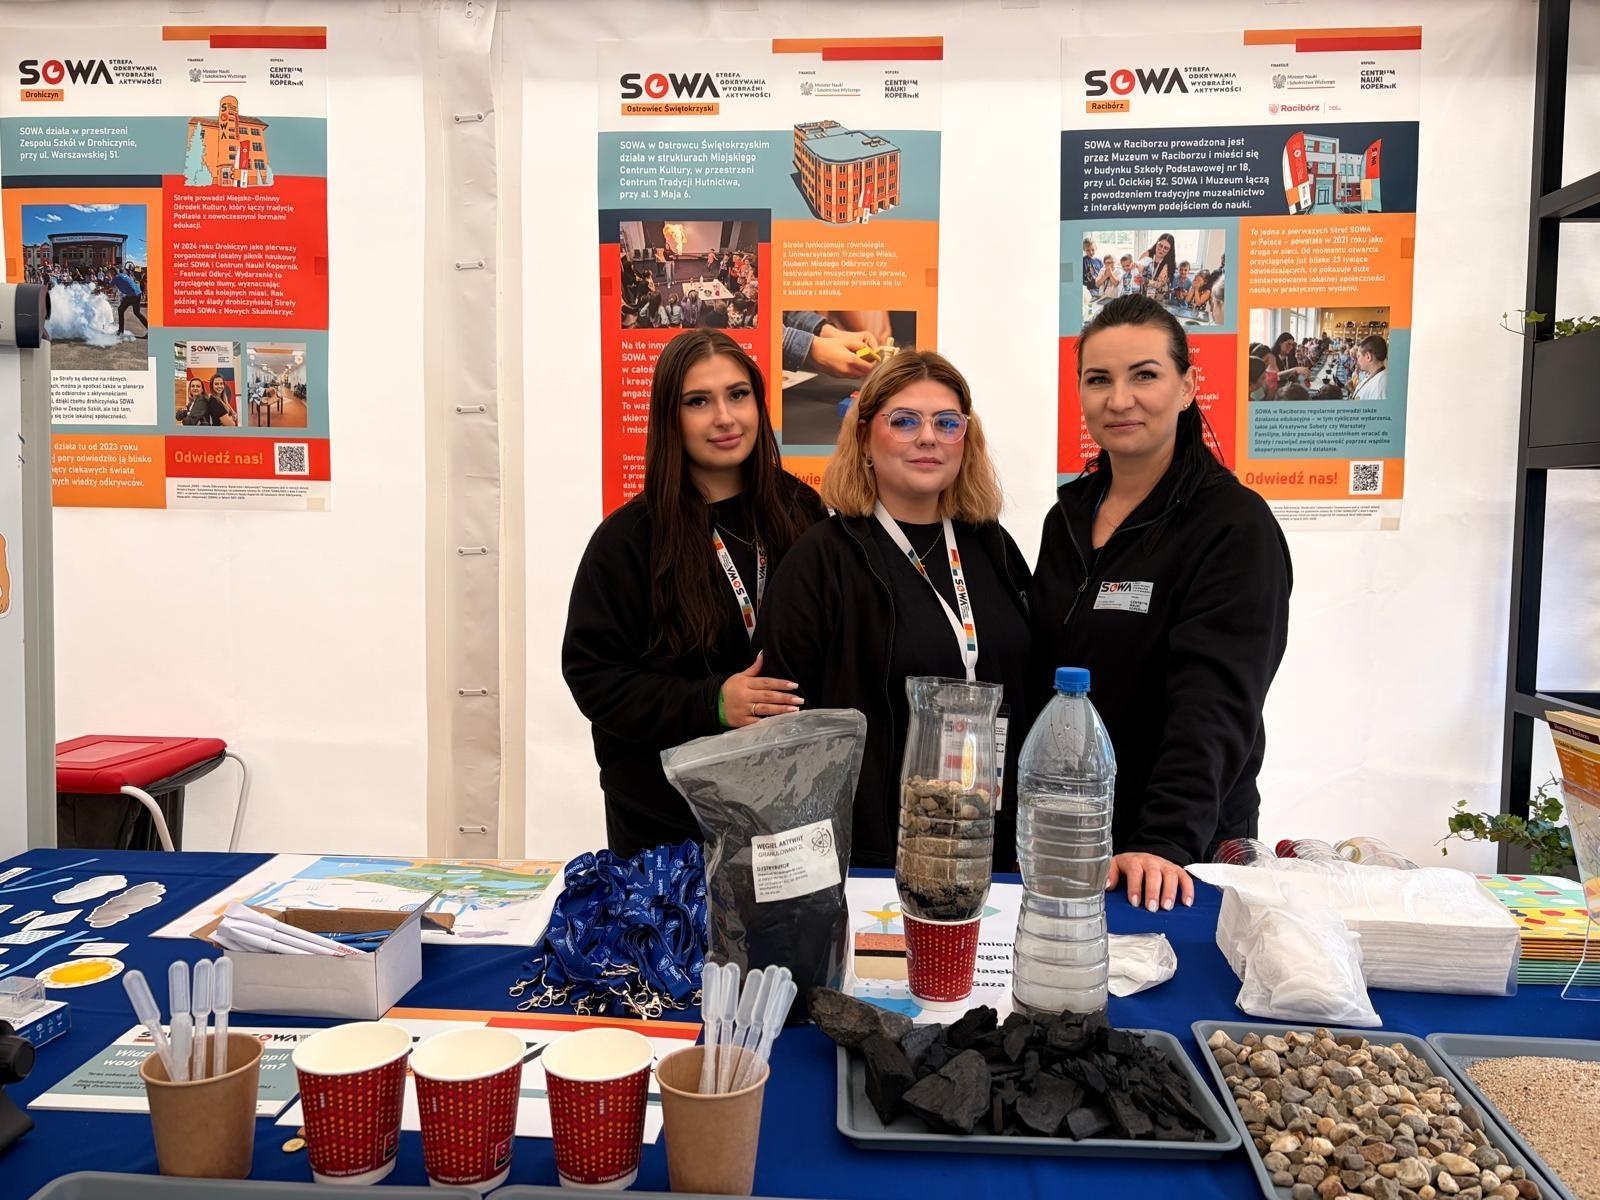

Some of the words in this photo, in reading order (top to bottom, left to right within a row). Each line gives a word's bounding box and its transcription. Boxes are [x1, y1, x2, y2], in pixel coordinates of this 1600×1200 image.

[18, 60, 113, 85] SOWA
[620, 73, 720, 99] SOWA
[1084, 68, 1189, 96] SOWA
[25, 90, 59, 99] Drohiczyn
[664, 104, 714, 113] Świętokrzyski
[1092, 102, 1123, 110] Racibórz
[1281, 104, 1320, 112] Racibórz
[81, 126, 128, 136] przestrzeni
[20, 139, 51, 148] Zespołu
[87, 139, 137, 148] Drohiczynie,
[620, 141, 645, 149] SOWA
[658, 141, 698, 149] Ostrowcu
[701, 139, 770, 151] Świętokrzyskim
[1084, 140, 1110, 149] SOWA
[1124, 138, 1167, 148] Raciborzu
[1170, 137, 1224, 149] prowadzona
[1228, 137, 1244, 148] jest
[51, 150, 106, 160] Warszawskiej
[620, 153, 644, 162] działa
[657, 153, 707, 162] strukturach
[710, 153, 756, 163] Miejskiego
[1084, 155, 1108, 163] przez
[1111, 152, 1148, 161] Muzeum
[1161, 150, 1206, 160] Raciborzu
[1214, 150, 1242, 159] mieści
[1245, 150, 1259, 160] się
[620, 165, 656, 174] Centrum
[659, 165, 692, 176] Kultury,
[705, 165, 754, 175] przestrzeni
[1094, 165, 1131, 176] budynku
[1134, 165, 1163, 176] Szkoły
[1165, 164, 1224, 175] Podstawowej
[1239, 163, 1251, 173] 18,
[620, 178, 656, 186] Centrum
[660, 177, 692, 188] Tradycji
[695, 177, 740, 187] Hutnictwa,
[1084, 180, 1102, 189] przy
[1105, 178, 1115, 186] ul.
[1118, 177, 1152, 188] Ocickiej
[1155, 177, 1167, 186] 52.
[1171, 176, 1197, 185] SOWA
[1205, 175, 1242, 185] Muzeum
[1245, 175, 1269, 186] łączą
[620, 192, 638, 200] przy
[640, 190, 650, 198] al.
[653, 190, 658, 198] 3
[661, 190, 681, 200] Maja
[683, 190, 691, 198] 6.
[1091, 189, 1151, 201] powodzeniem
[1154, 188, 1199, 200] tradycyjne
[1202, 187, 1265, 197] muzealnictwo
[1091, 202, 1156, 213] interaktywnym
[1159, 201, 1209, 212] podejściem
[1211, 200, 1222, 209] do
[1225, 200, 1252, 209] nauki.
[648, 342, 668, 350] inny
[632, 364, 654, 373] całoś
[118, 455, 126, 464] ją
[174, 451, 229, 464] Odwiedź
[235, 452, 263, 464] nas!
[1246, 472, 1303, 484] Odwiedź
[1309, 472, 1338, 484] nas!
[727, 566, 745, 595] SOWA
[955, 578, 967, 606] SOWA
[1101, 582, 1132, 592] SOWA
[116, 1050, 149, 1058] Widz
[104, 1059, 142, 1067] wody
